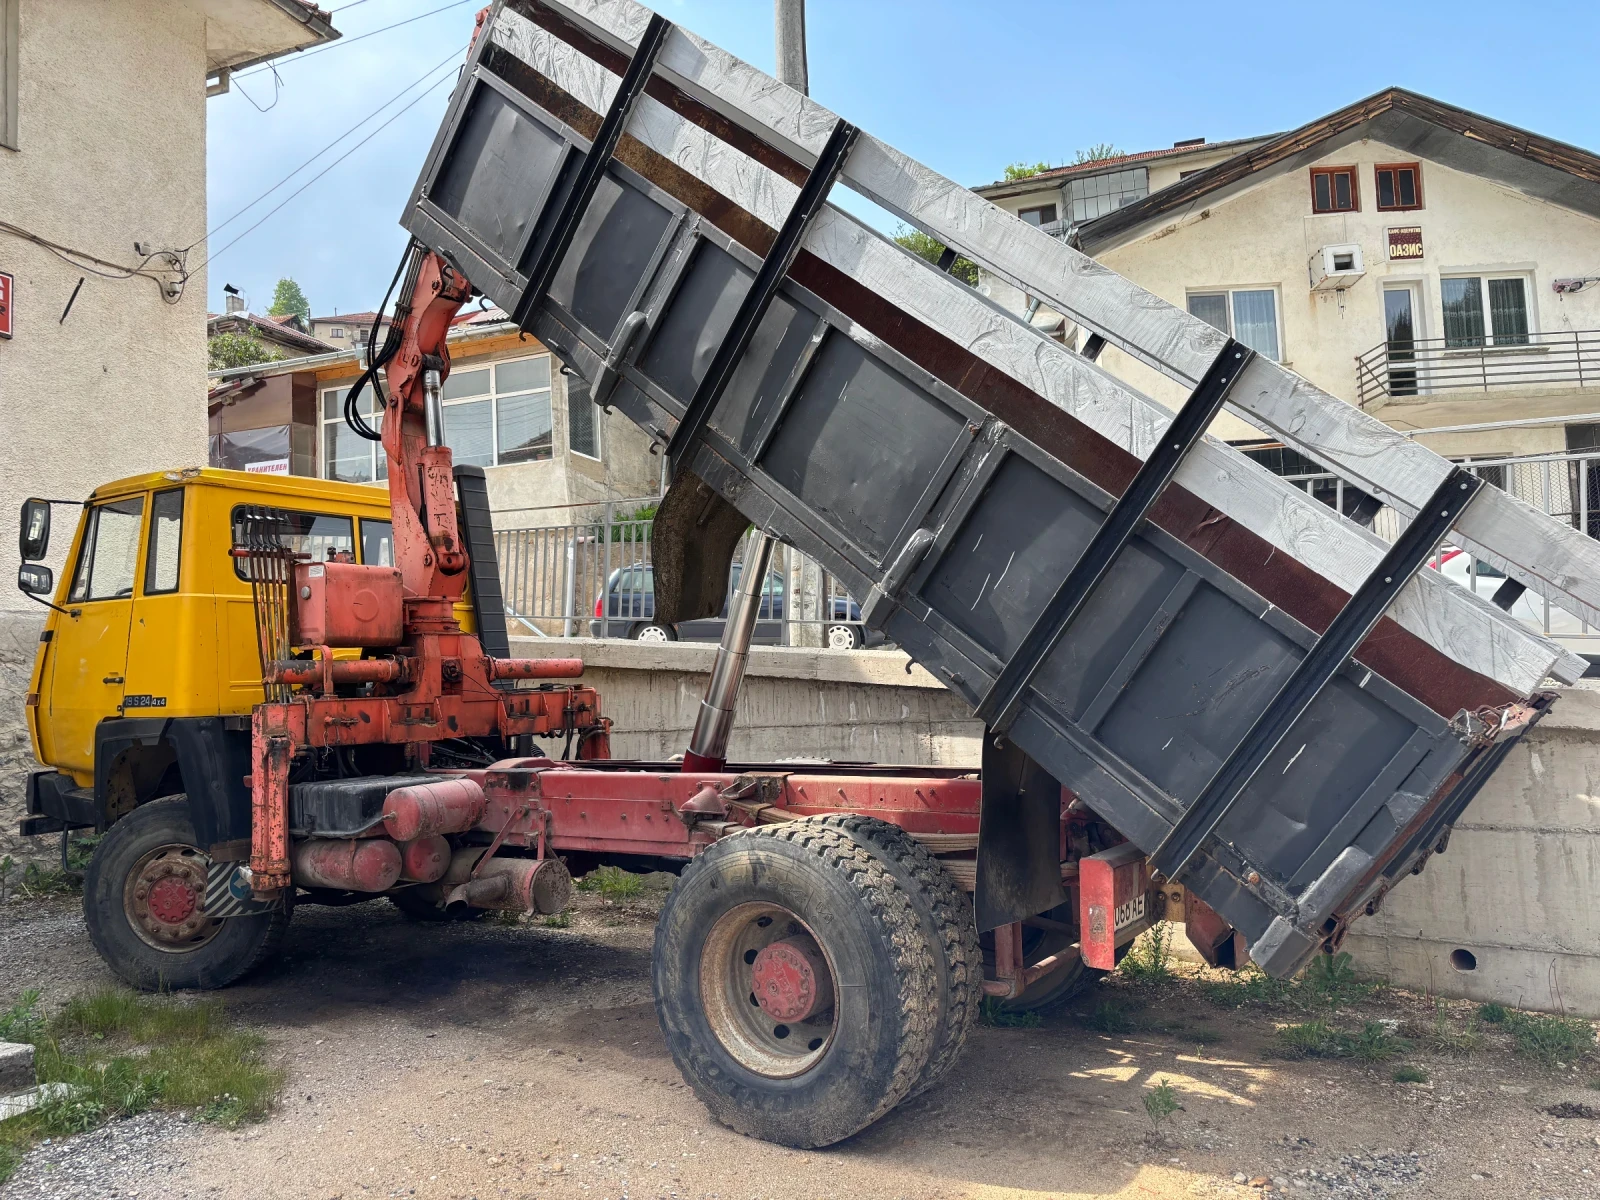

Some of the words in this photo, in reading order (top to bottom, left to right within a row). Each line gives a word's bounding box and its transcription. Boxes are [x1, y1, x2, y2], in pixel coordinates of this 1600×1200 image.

[1390, 243, 1423, 257] ОАЗИС
[125, 696, 133, 706] 19
[140, 696, 150, 706] 24
[152, 698, 166, 706] 4x4
